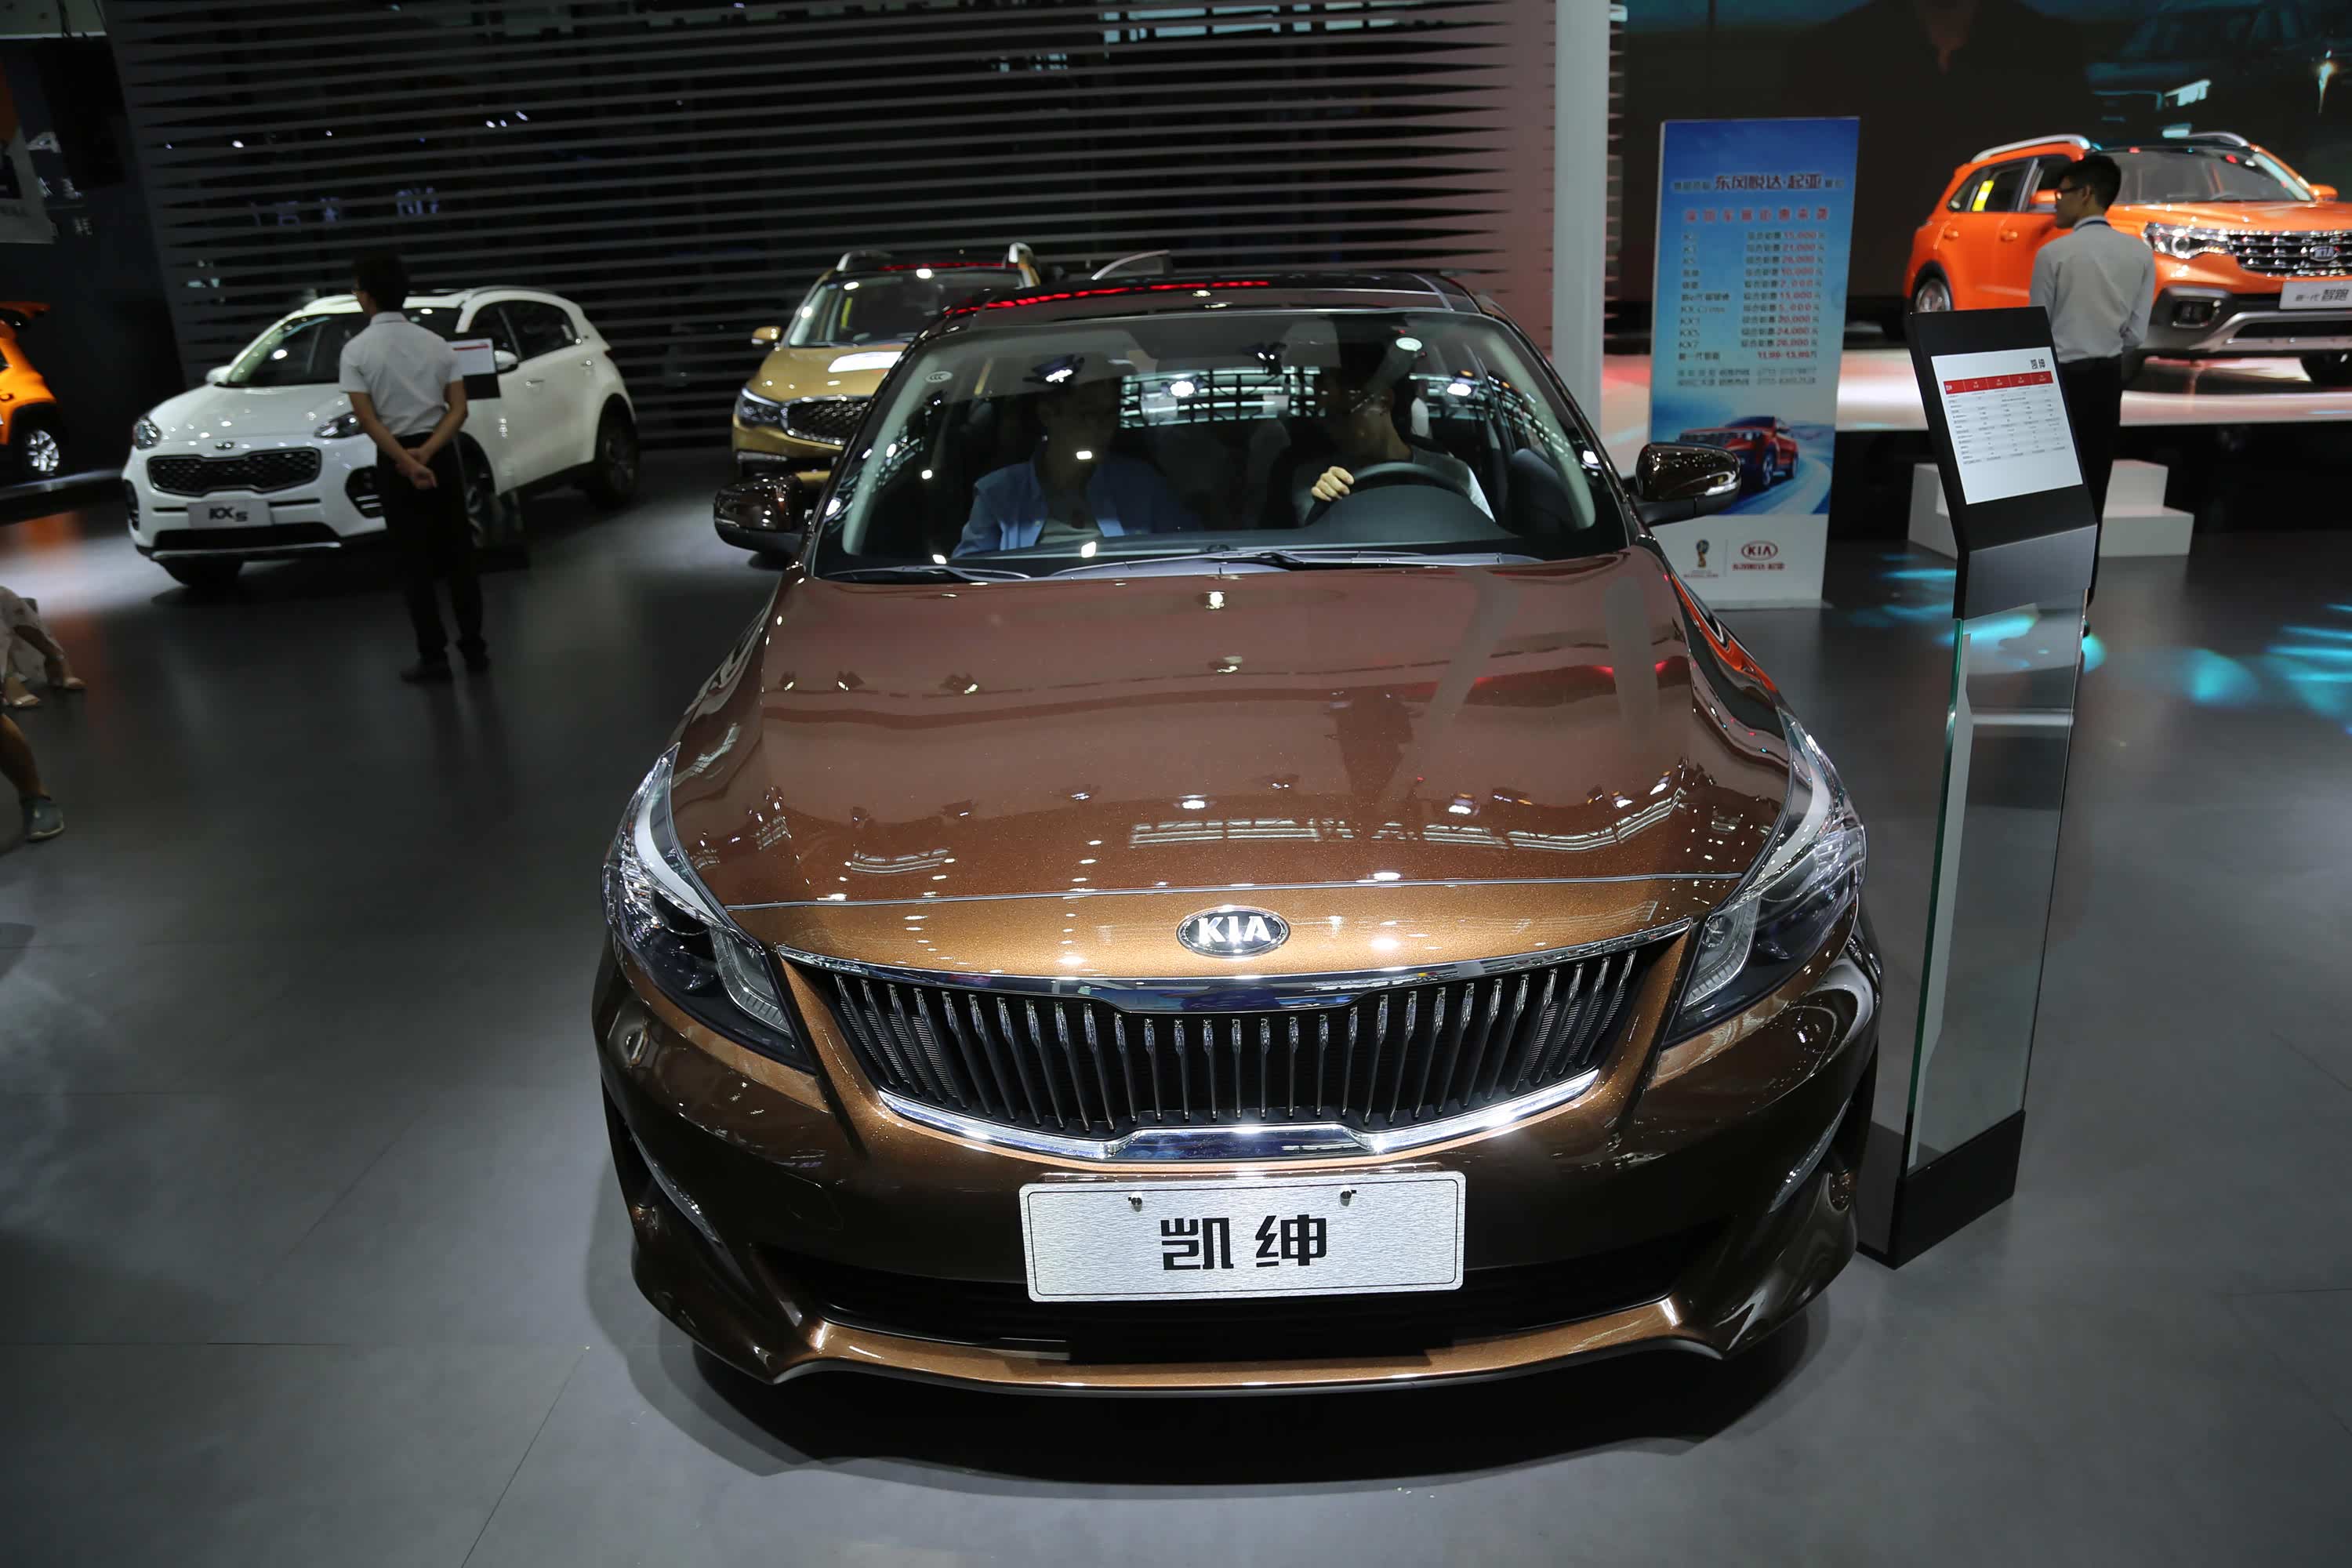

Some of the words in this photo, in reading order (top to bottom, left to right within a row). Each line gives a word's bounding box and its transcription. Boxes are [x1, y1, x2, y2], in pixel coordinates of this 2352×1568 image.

[1748, 546, 1772, 556] KIA
[1196, 913, 1272, 944] KIA
[1160, 1214, 1327, 1271] 凯绅
